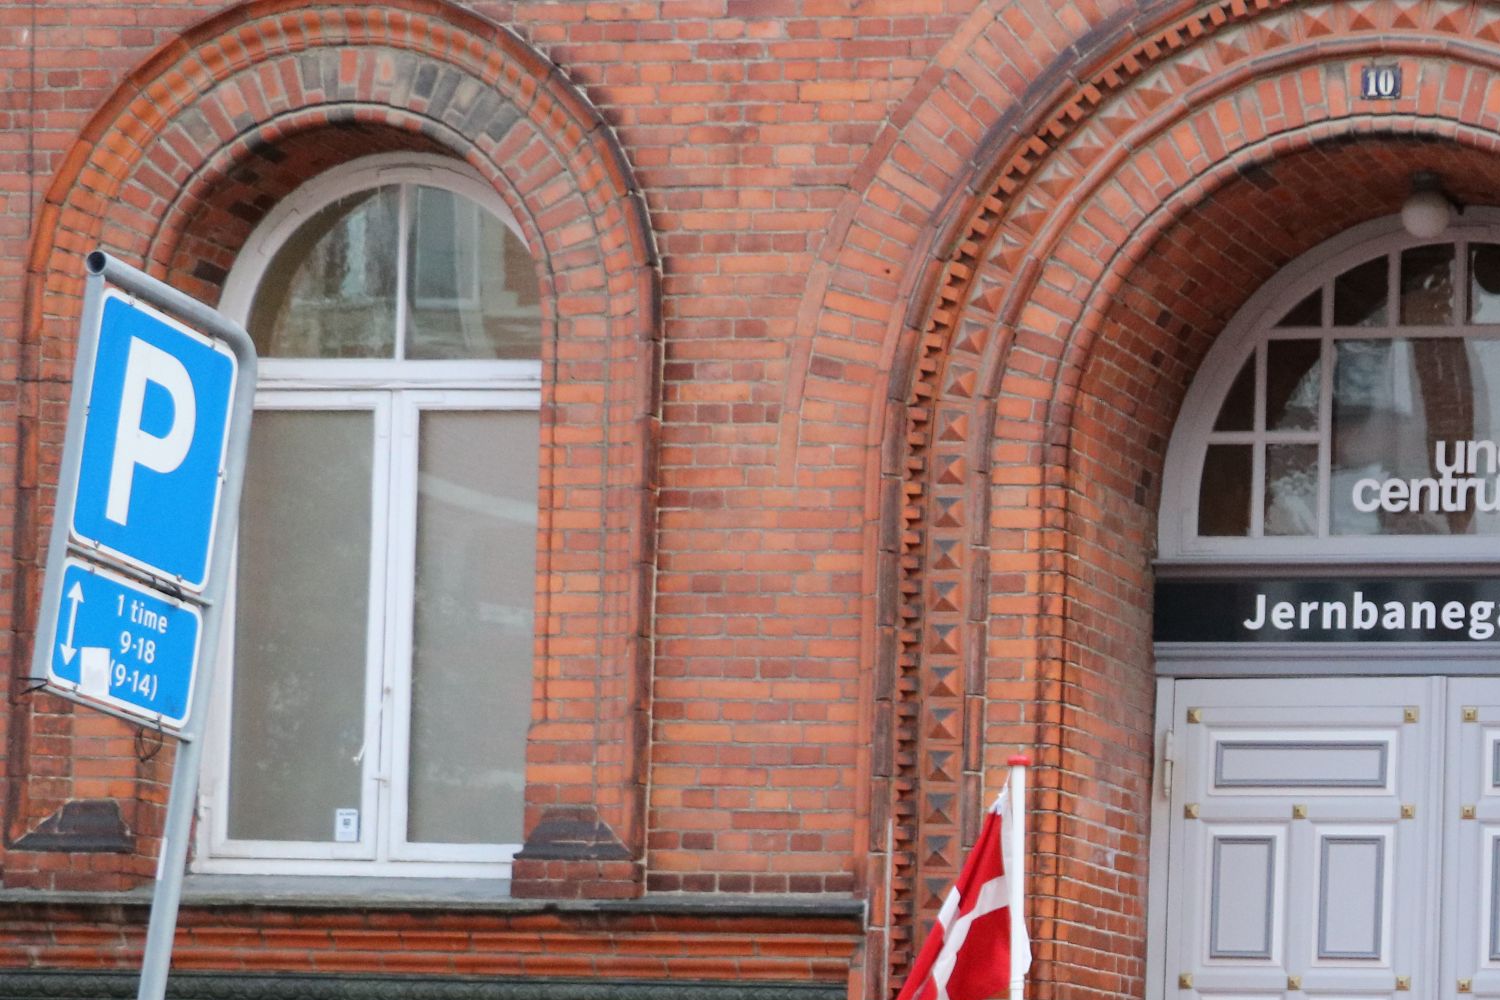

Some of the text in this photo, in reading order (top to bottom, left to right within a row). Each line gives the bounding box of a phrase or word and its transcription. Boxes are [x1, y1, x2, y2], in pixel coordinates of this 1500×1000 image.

[1367, 69, 1395, 96] 10
[105, 335, 196, 526] P
[117, 594, 168, 634] 1 time
